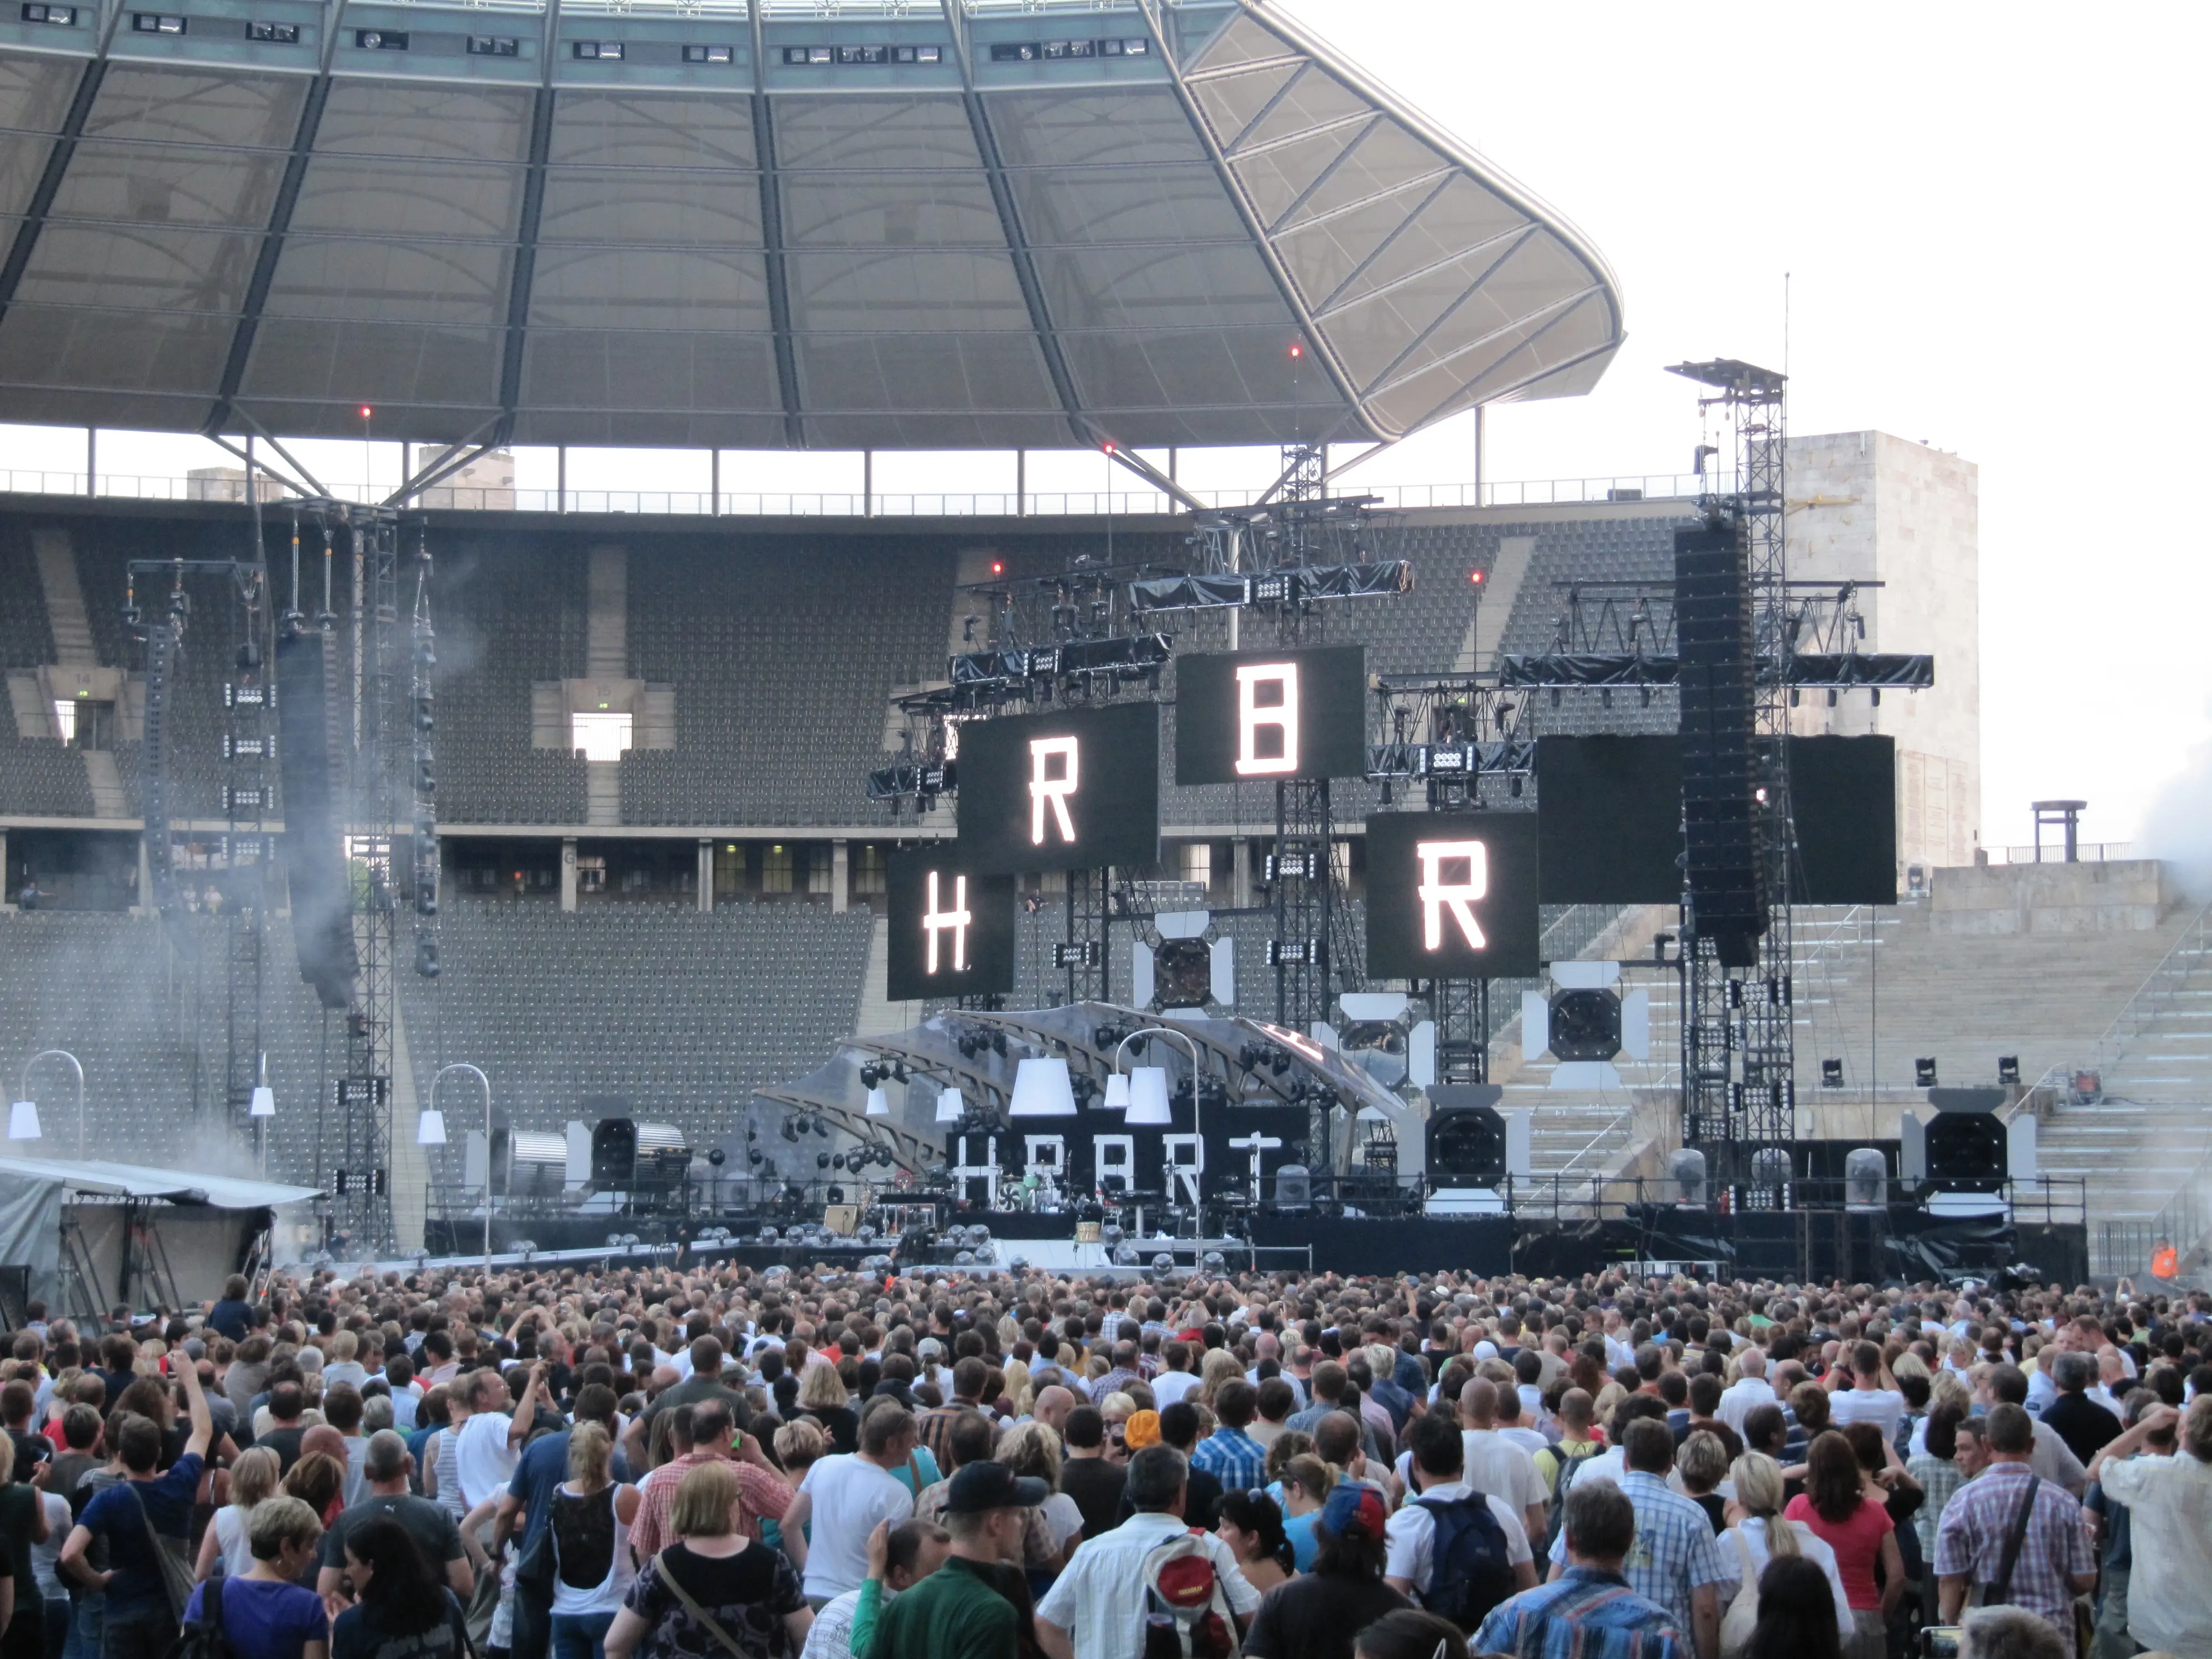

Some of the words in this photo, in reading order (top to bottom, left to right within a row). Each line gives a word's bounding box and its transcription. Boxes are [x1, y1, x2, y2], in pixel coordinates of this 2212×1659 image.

[1235, 662, 1298, 775] B
[1029, 735, 1078, 845] R
[565, 852, 576, 864] G
[1417, 840, 1487, 951] R
[924, 871, 971, 974] H
